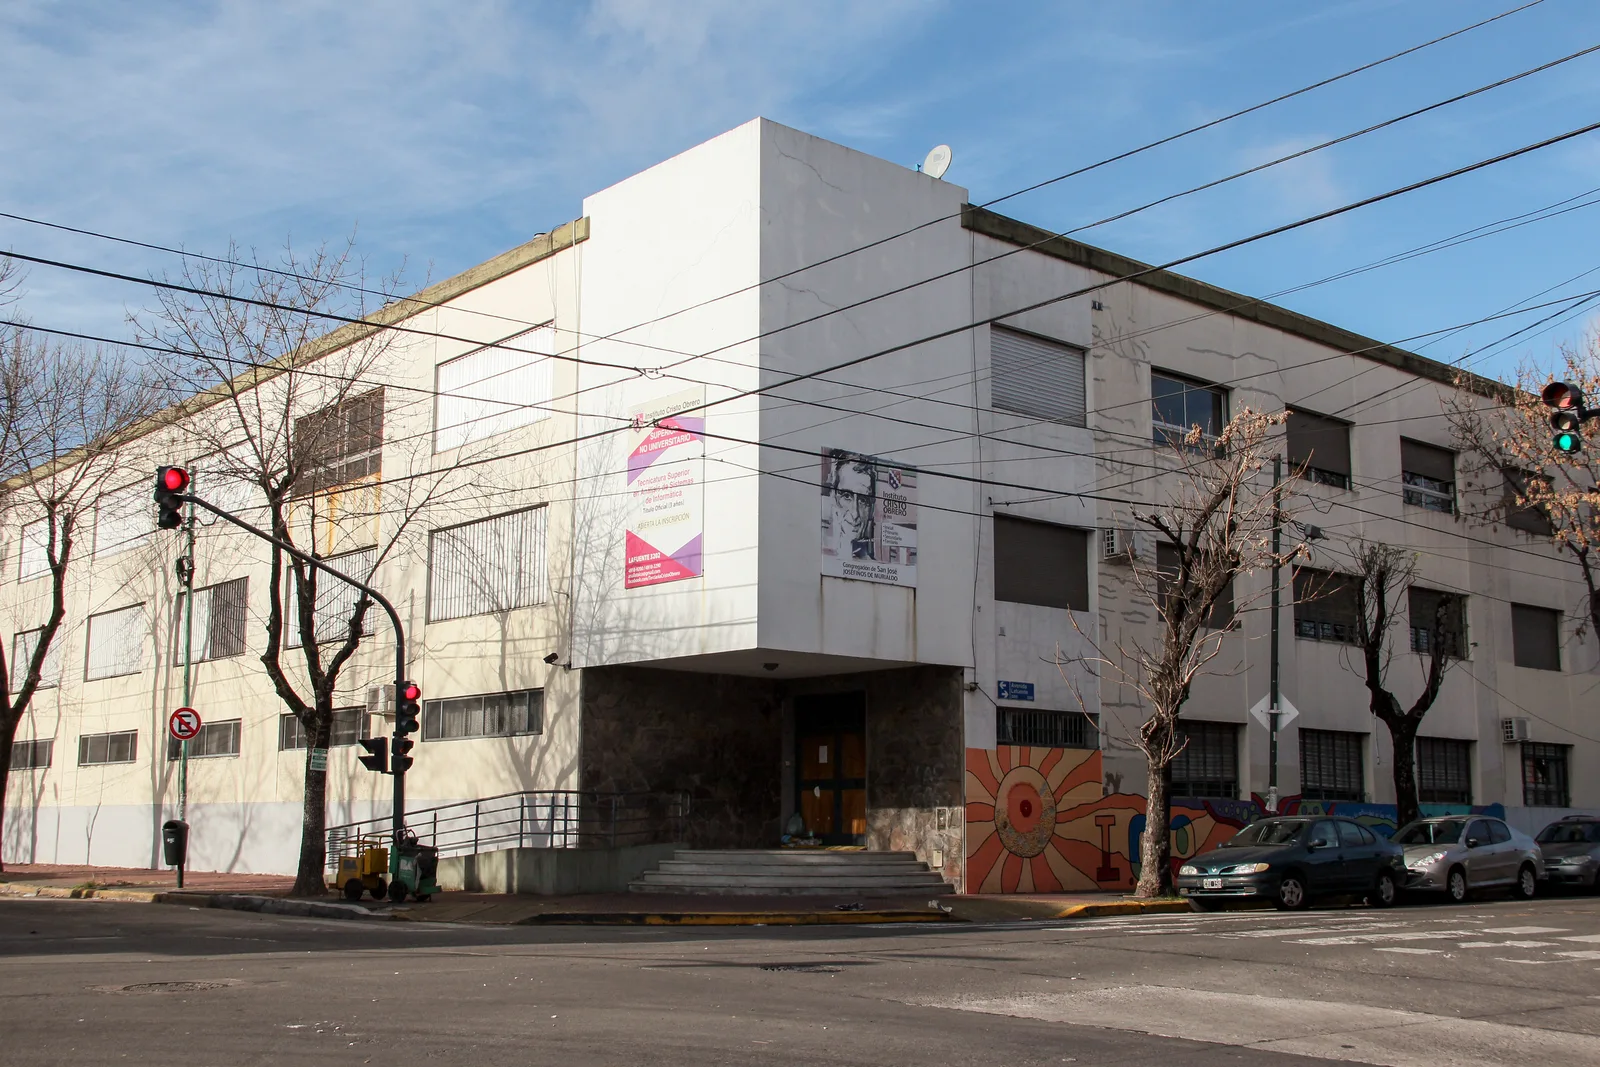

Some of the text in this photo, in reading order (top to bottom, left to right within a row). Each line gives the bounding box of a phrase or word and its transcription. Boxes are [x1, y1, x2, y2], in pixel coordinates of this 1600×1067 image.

[645, 399, 700, 418] Instituto Cristo Obrero
[640, 434, 690, 453] NO UNIVERSITARIO
[638, 469, 690, 486] Tecnicatura Superior
[670, 478, 693, 488] Sistemas
[883, 491, 906, 500] Instituto
[883, 499, 906, 509] CRISTO
[883, 507, 906, 516] OBRERO
[629, 554, 649, 563] LAFUENTE
